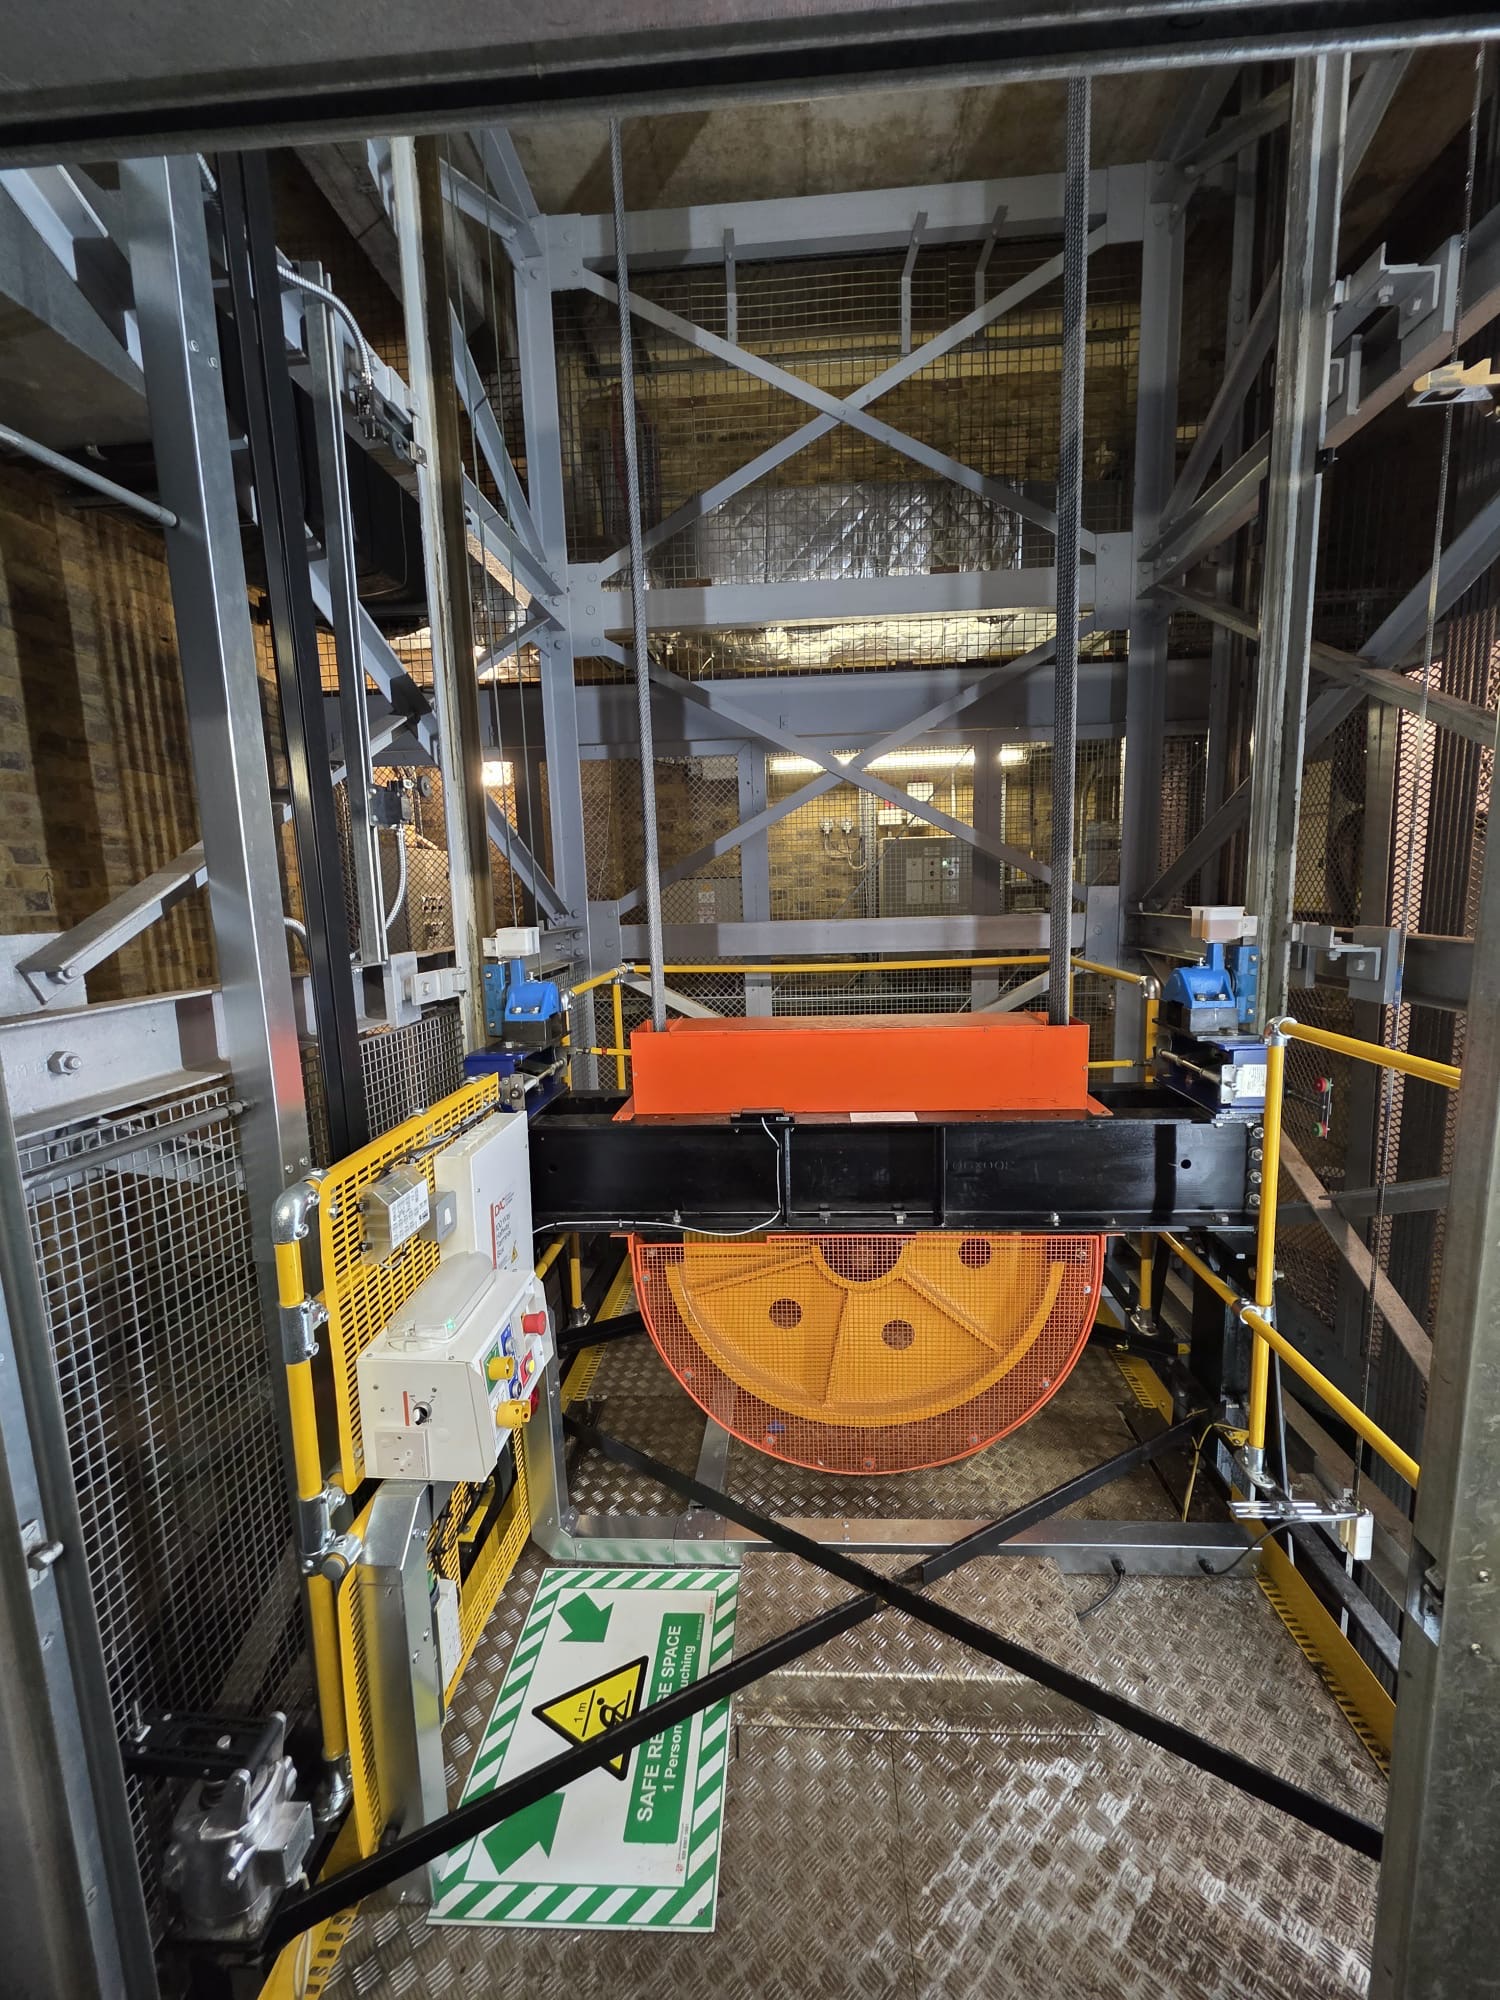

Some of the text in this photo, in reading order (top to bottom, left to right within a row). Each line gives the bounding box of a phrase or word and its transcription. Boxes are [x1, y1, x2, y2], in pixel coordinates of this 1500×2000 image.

[578, 1702, 587, 1712] m
[637, 1764, 660, 1822] SAFE
[661, 1625, 682, 1677] SPACE
[664, 1725, 683, 1779] Person
[662, 1784, 675, 1793] 1
